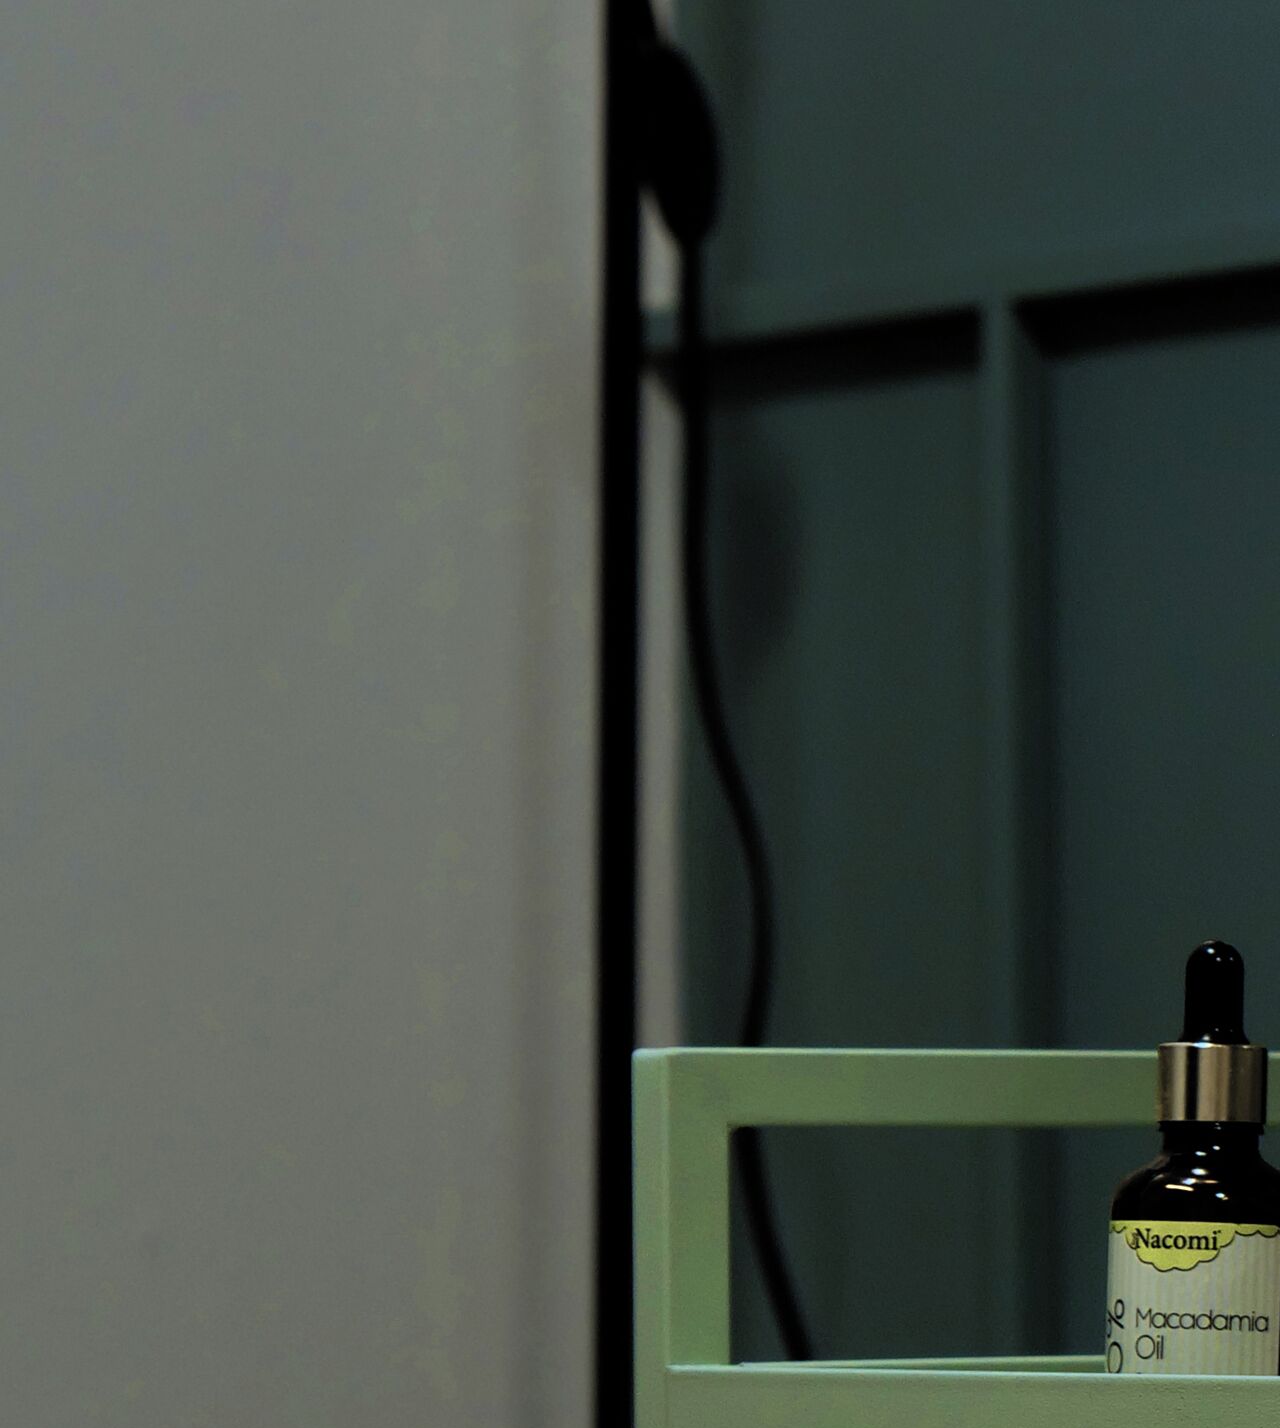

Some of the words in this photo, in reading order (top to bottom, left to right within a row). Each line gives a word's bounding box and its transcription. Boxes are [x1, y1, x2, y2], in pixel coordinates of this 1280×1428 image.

[1134, 1228, 1218, 1251] Nacomi
[1135, 1307, 1269, 1332] Macadamia
[1135, 1334, 1164, 1360] Oil
